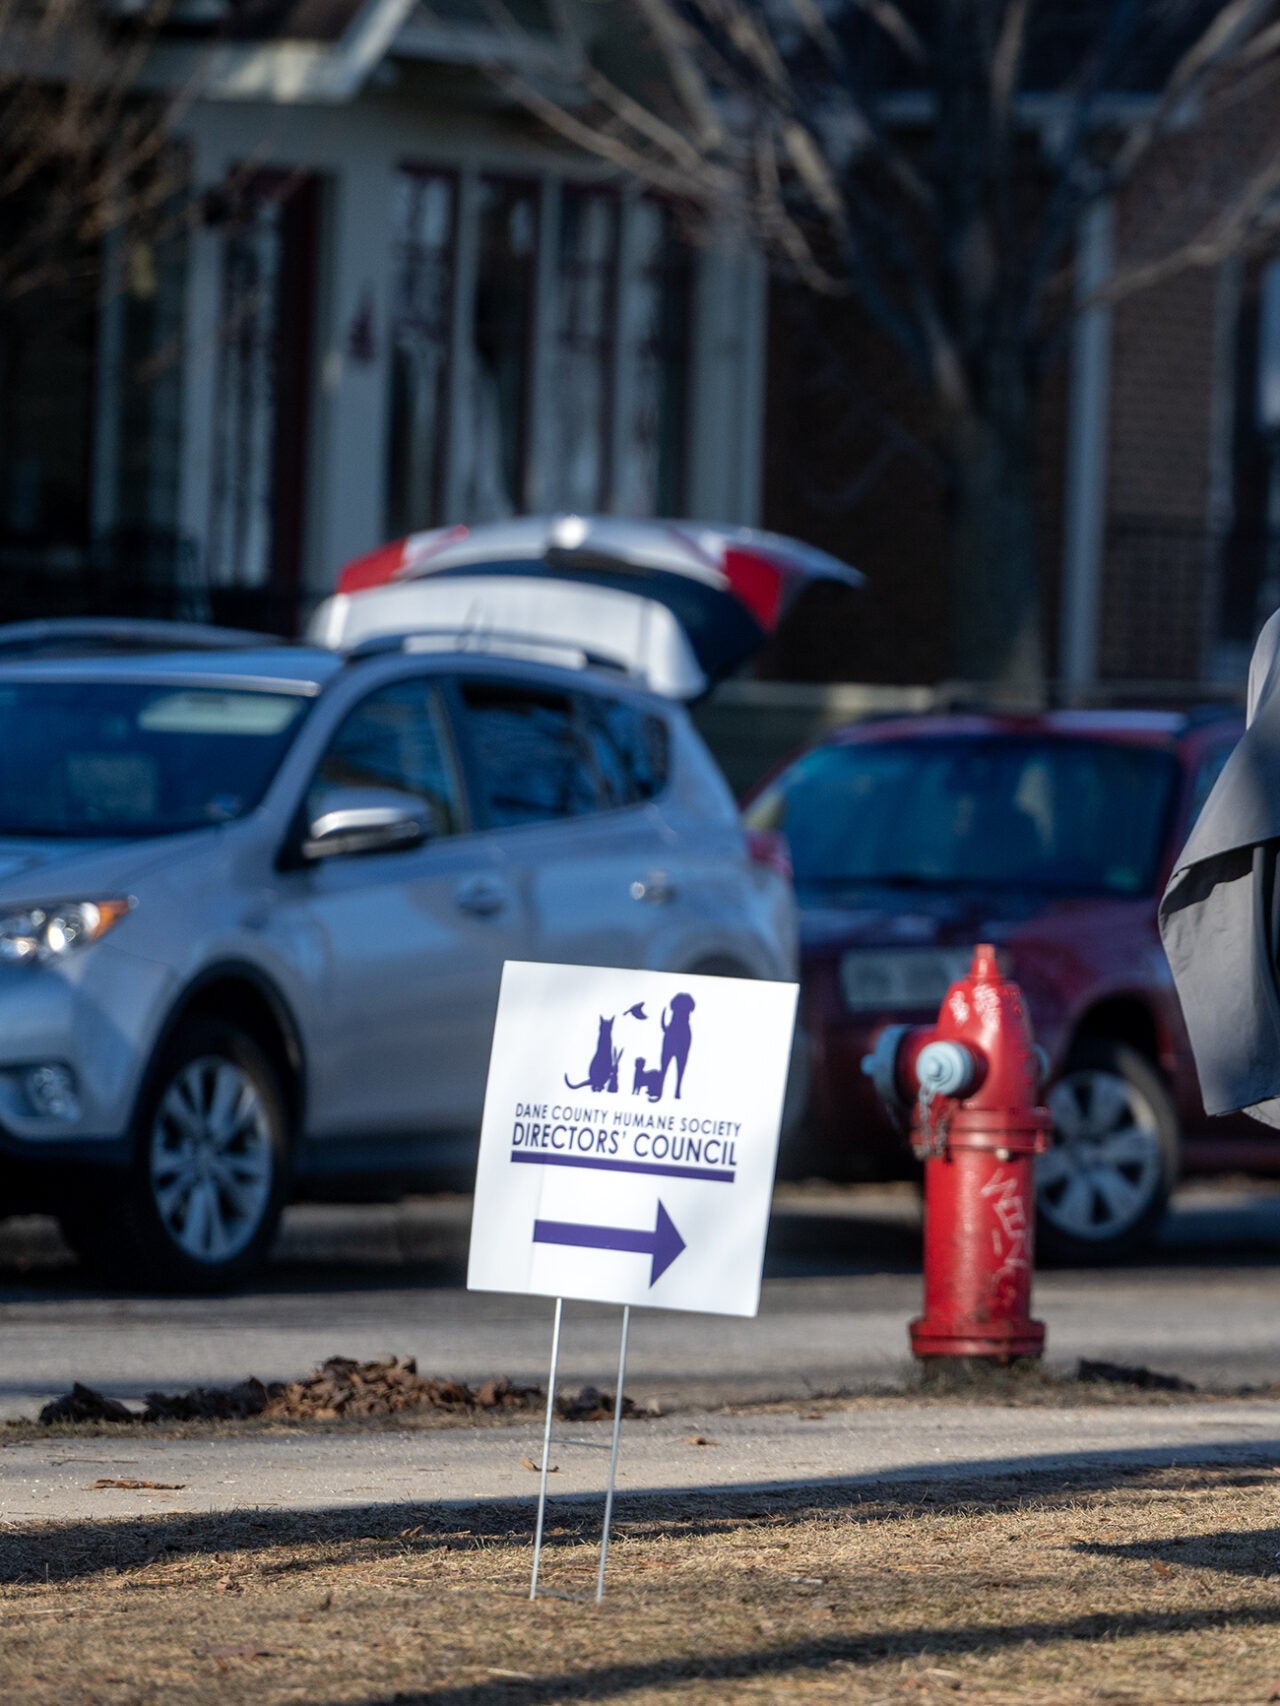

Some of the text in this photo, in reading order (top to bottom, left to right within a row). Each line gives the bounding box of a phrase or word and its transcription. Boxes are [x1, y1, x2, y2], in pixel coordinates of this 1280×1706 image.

[515, 1102, 742, 1137] DANE COUNTY HUMANE SOCIETY
[512, 1121, 738, 1166] DIRECTORS' COUNCIL
